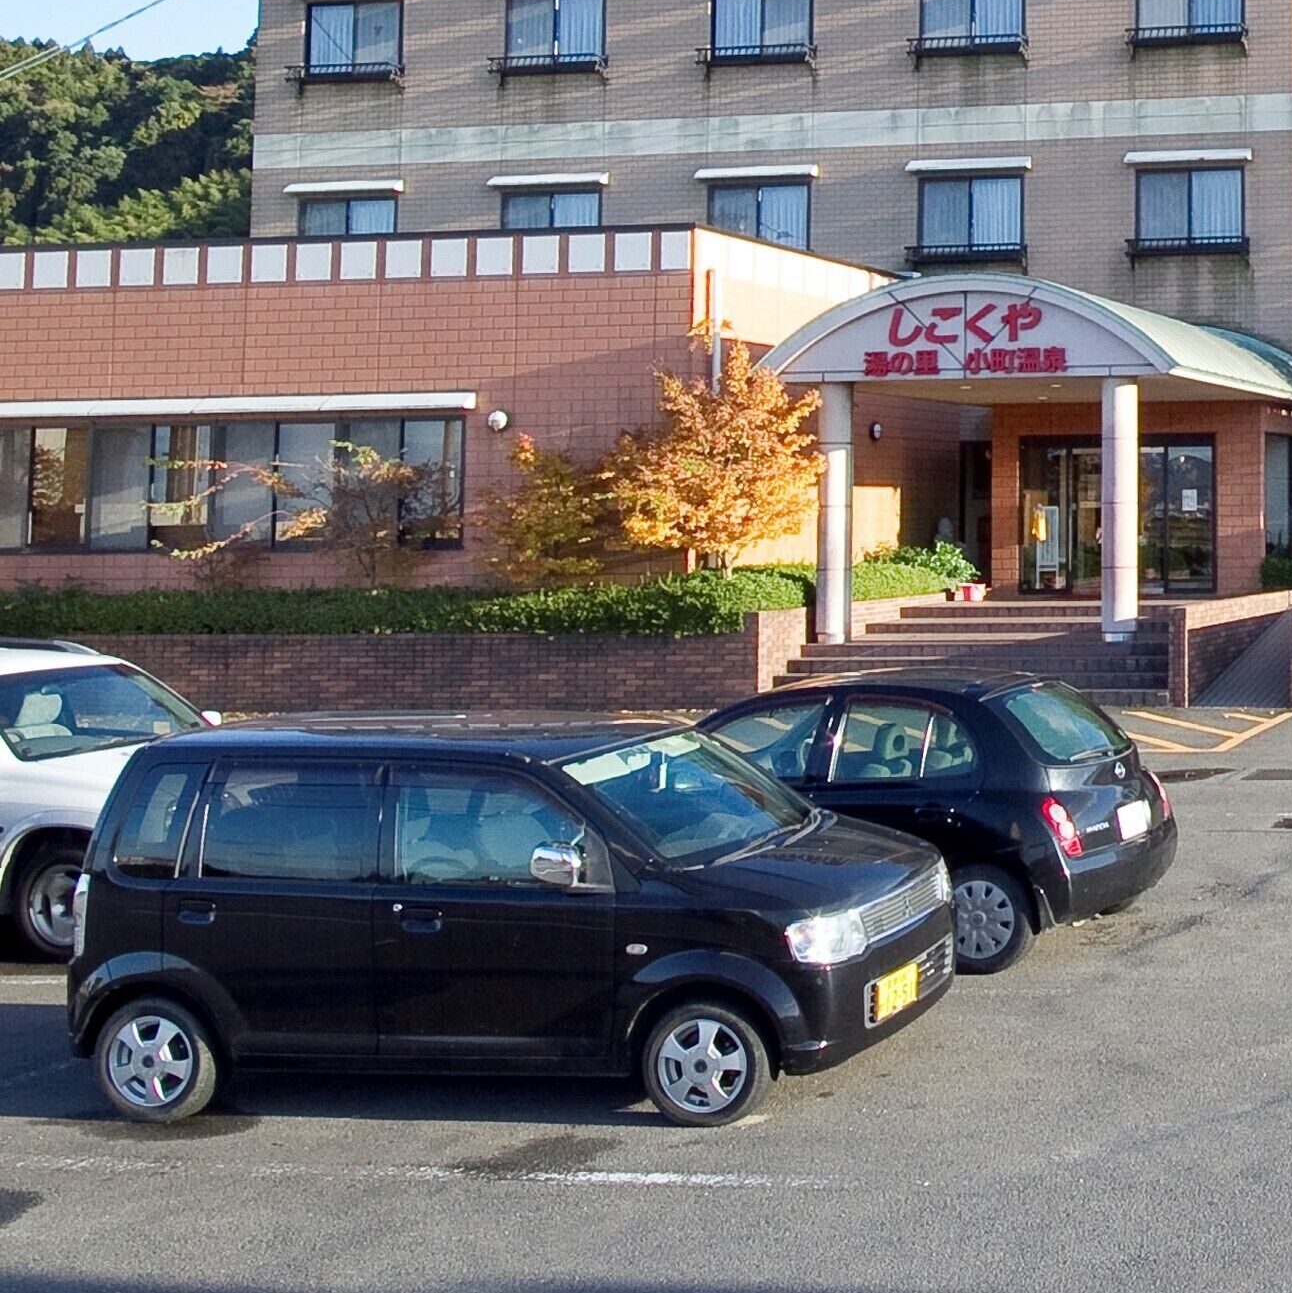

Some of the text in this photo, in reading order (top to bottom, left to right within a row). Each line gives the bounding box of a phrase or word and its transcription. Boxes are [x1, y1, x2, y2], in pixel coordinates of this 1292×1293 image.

[888, 303, 1043, 347] しこくや
[863, 346, 1068, 377] 湯の里 小町温泉
